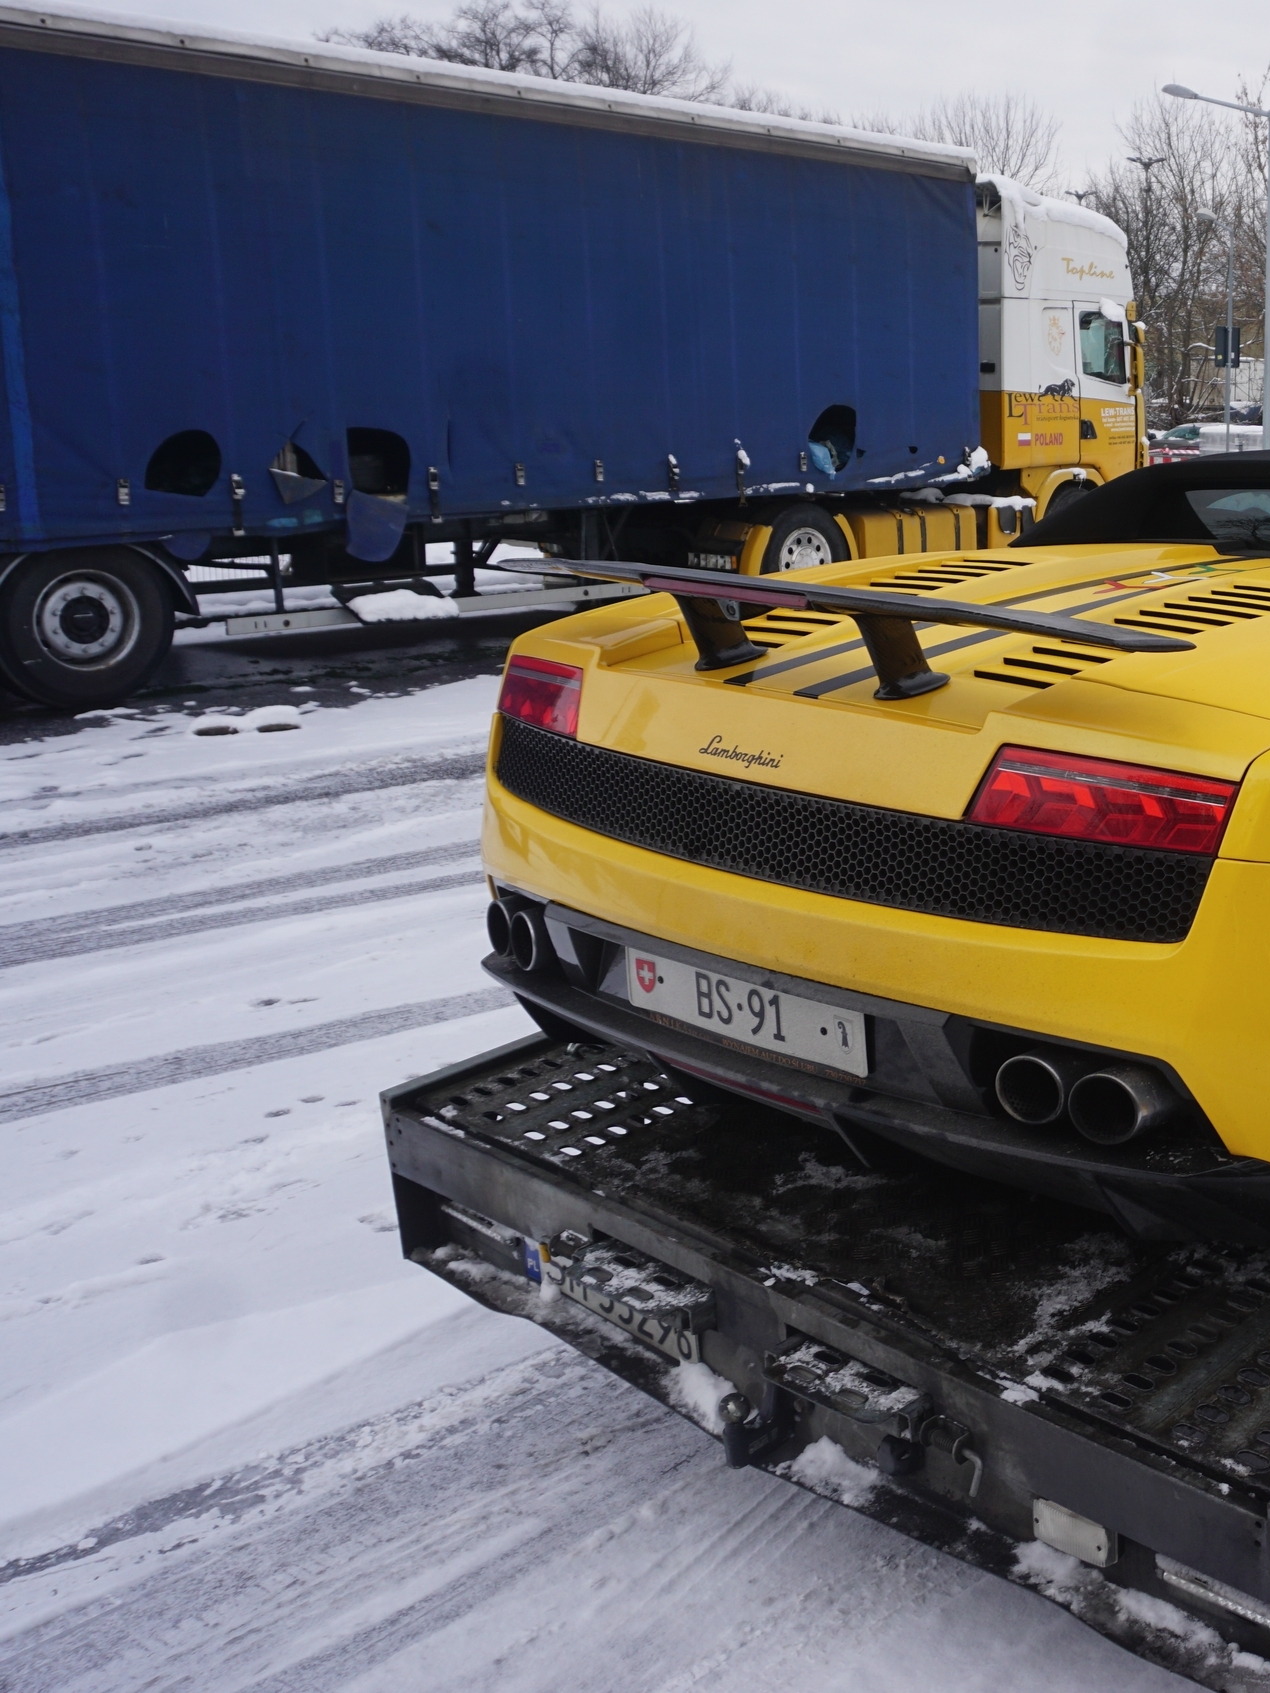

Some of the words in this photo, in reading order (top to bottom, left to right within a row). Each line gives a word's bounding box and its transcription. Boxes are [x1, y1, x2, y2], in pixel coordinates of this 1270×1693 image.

[1061, 257, 1115, 281] Topline
[1006, 392, 1038, 418] Lew
[1014, 402, 1080, 426] Trans
[1100, 406, 1135, 417] LEW-TRANS
[1034, 433, 1064, 446] POLAND
[699, 734, 784, 770] Lamborghini
[761, 1051, 777, 1062] AUT
[779, 1056, 791, 1065] DO
[527, 1257, 539, 1272] PL
